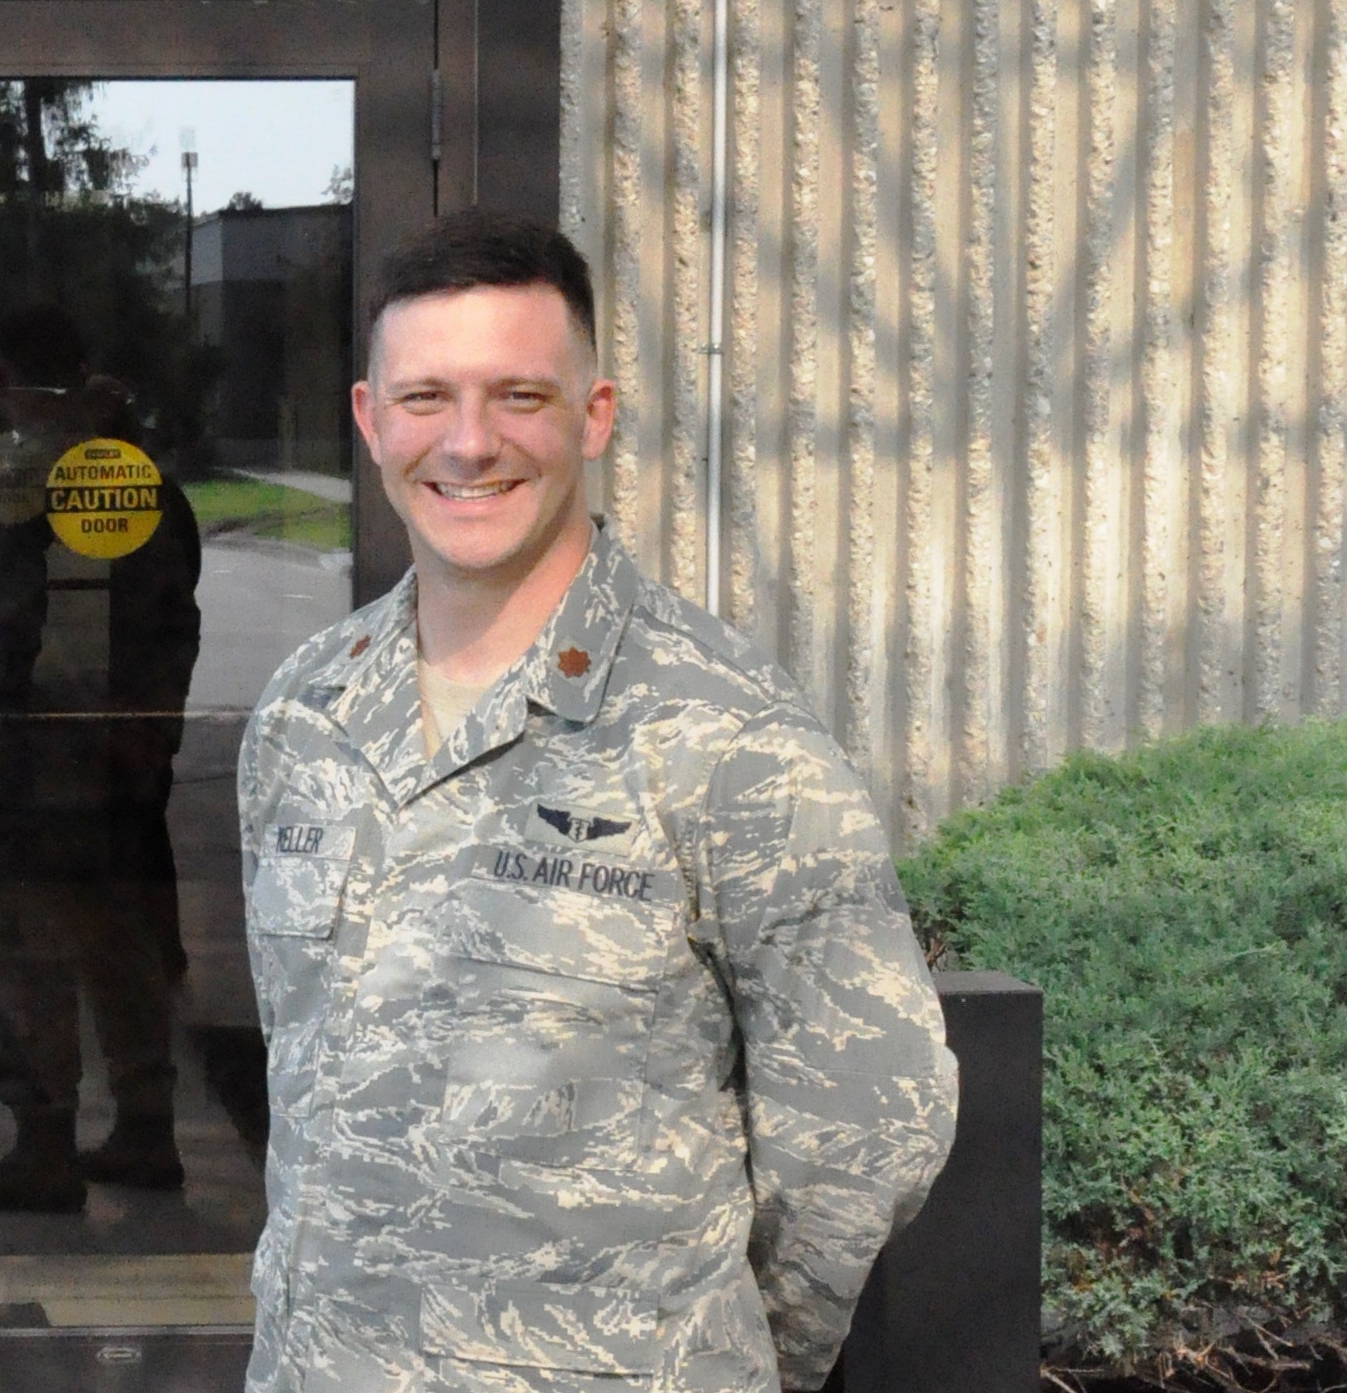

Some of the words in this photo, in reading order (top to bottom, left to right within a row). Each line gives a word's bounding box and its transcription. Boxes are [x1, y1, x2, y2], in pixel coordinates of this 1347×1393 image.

[54, 464, 152, 481] AUTOMATIC
[51, 488, 157, 510] CAUTION
[81, 518, 129, 533] DOOR
[493, 850, 528, 881] U.S.
[532, 857, 573, 888] AIR
[578, 862, 655, 902] FORCE
